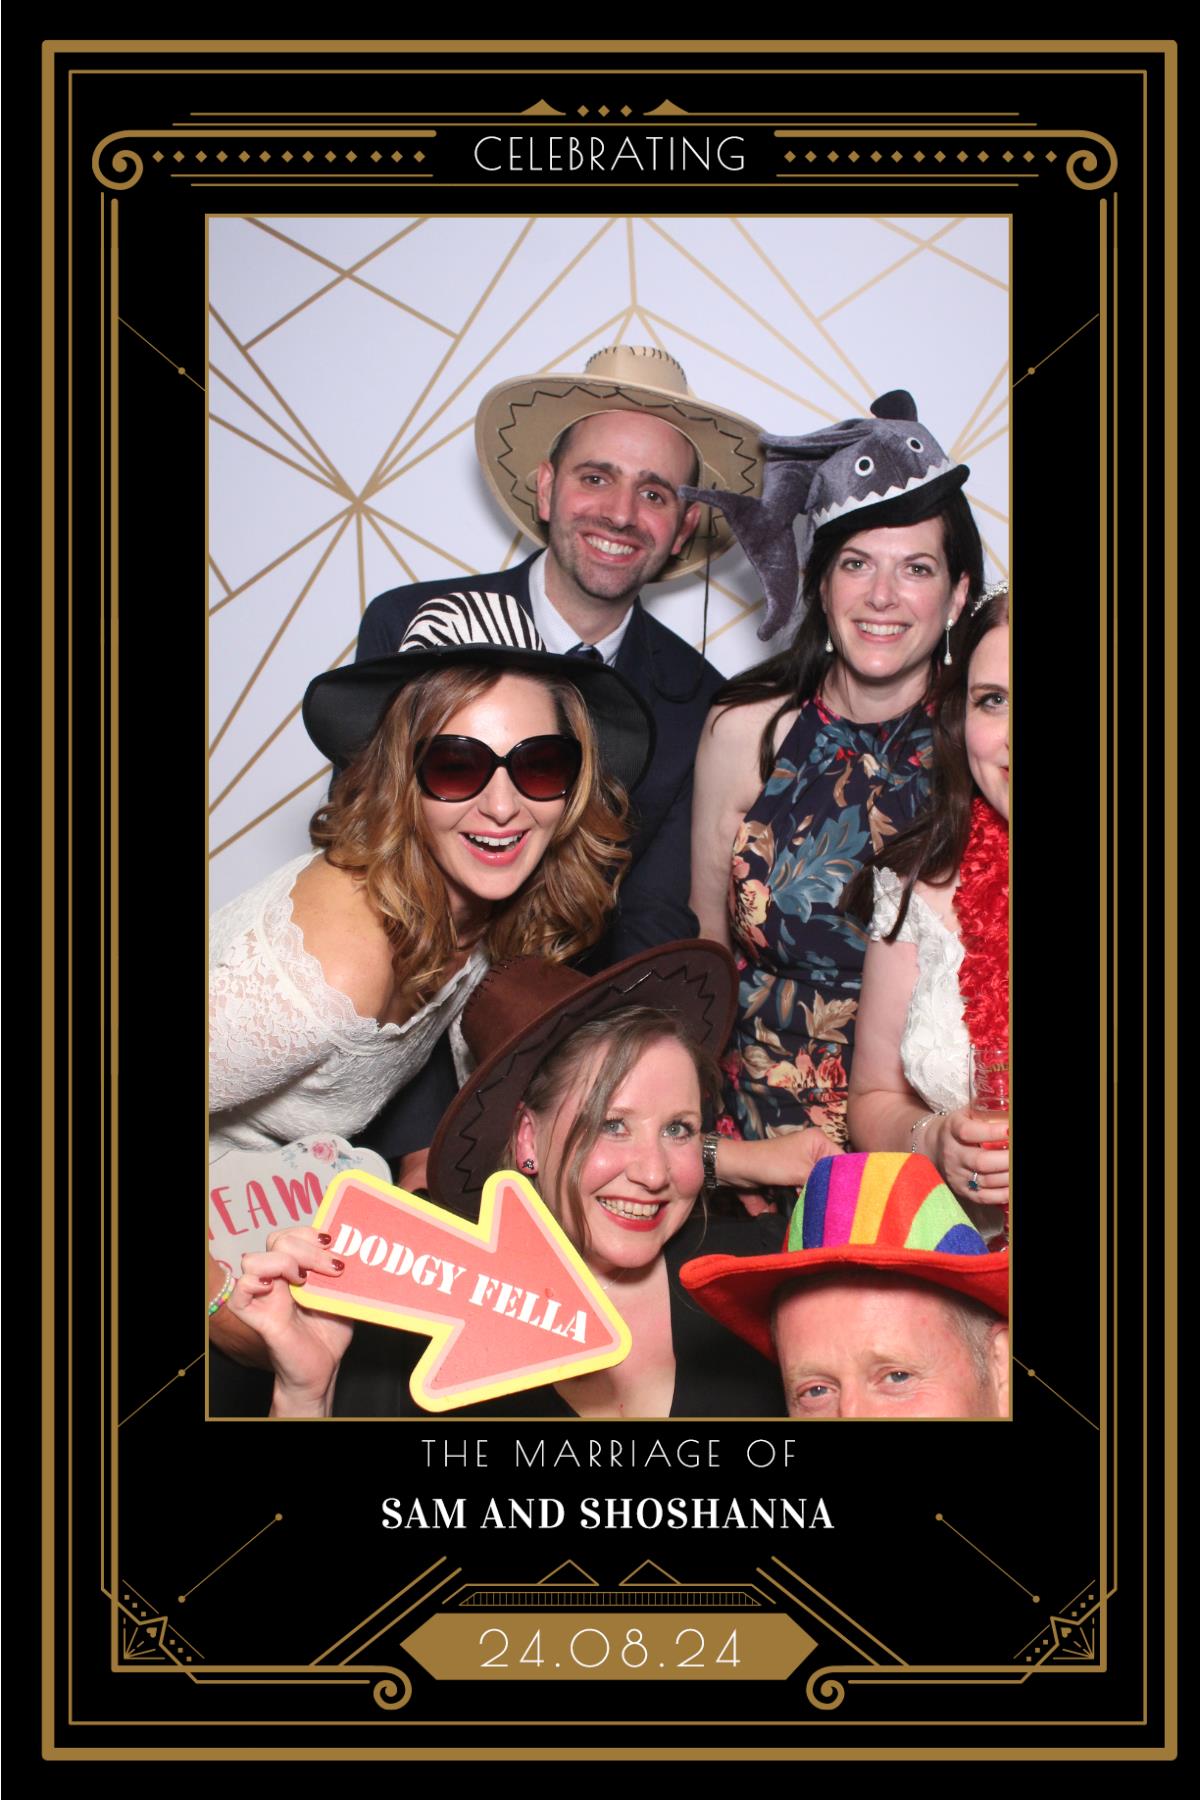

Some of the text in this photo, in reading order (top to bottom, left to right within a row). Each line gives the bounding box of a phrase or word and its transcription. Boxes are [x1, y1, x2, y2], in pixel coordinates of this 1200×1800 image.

[208, 1171, 325, 1241] EAM
[331, 1223, 588, 1344] DODGY FELLA
